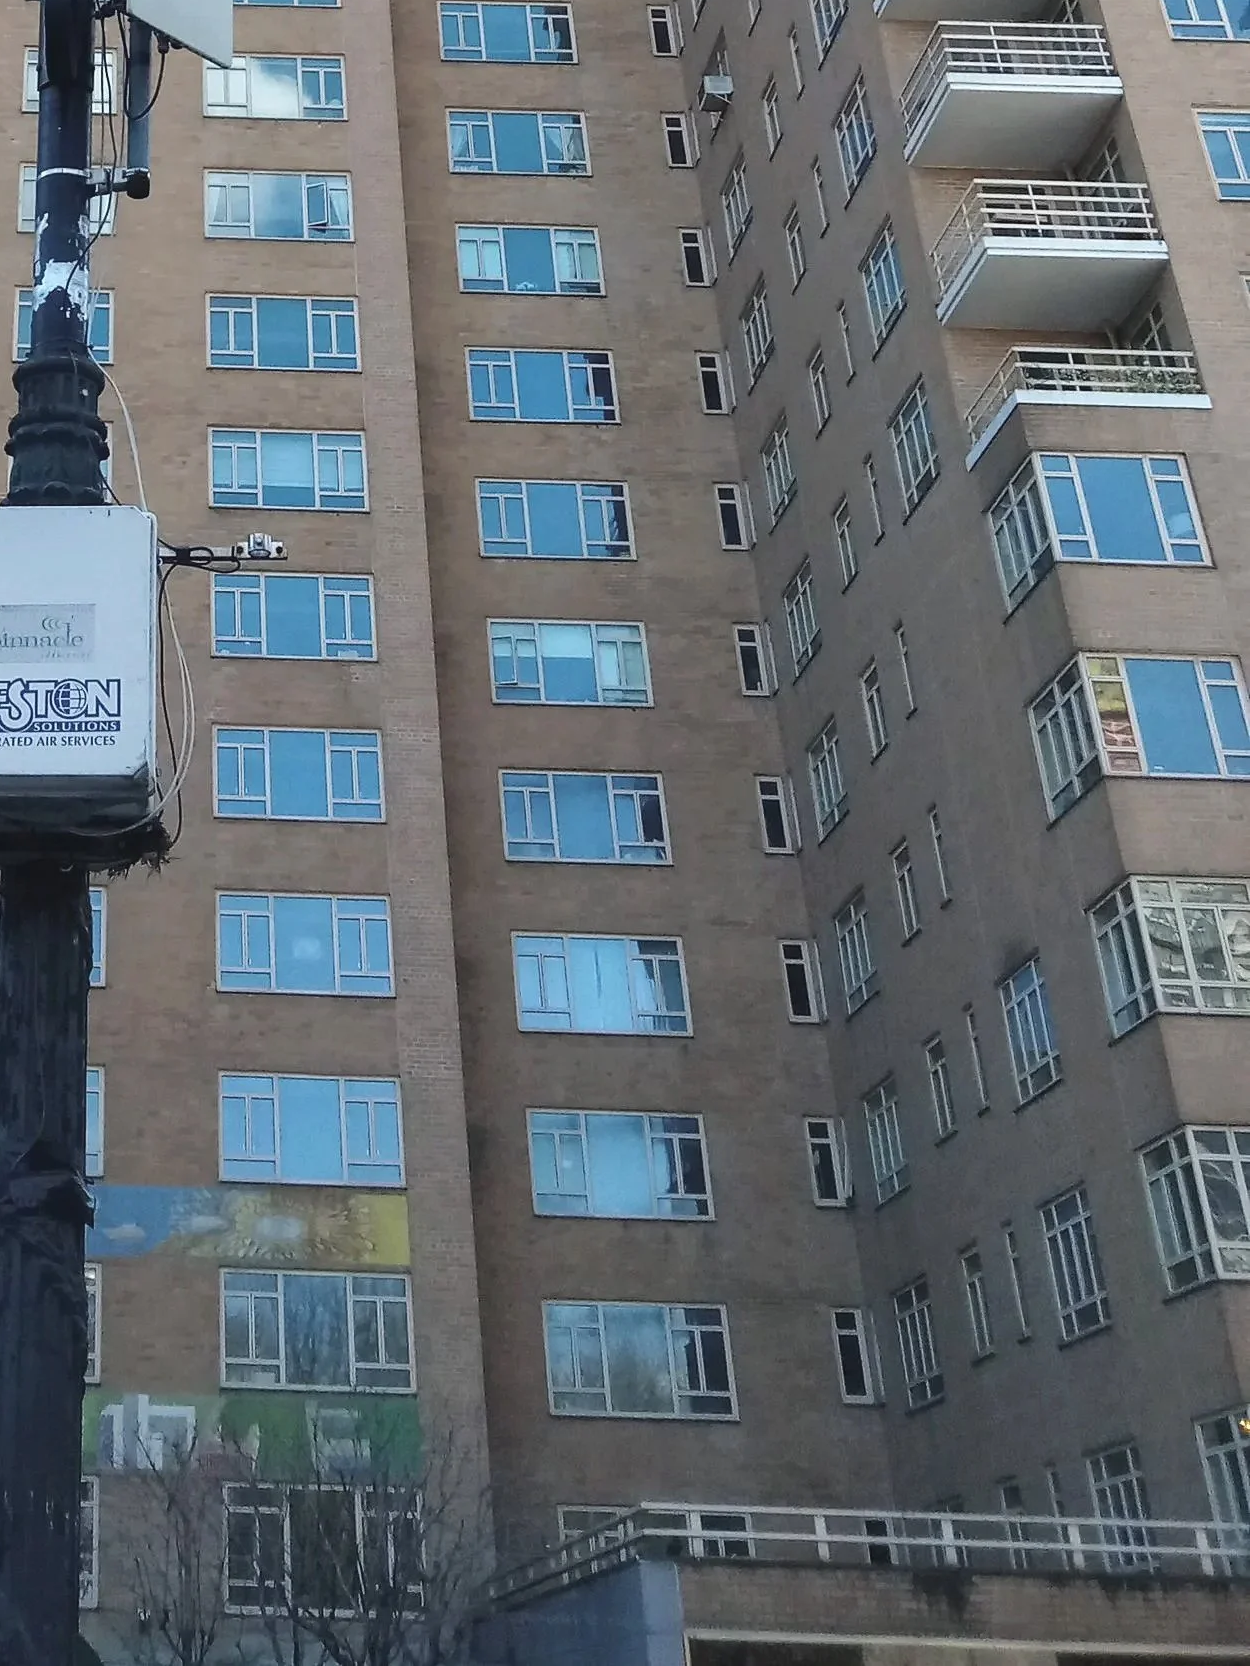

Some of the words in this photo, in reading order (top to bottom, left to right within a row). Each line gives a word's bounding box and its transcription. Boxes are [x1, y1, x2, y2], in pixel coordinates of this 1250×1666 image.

[33, 720, 118, 732] SOLUTIONS
[36, 736, 59, 747] AIR
[61, 735, 116, 746] SERVICES
